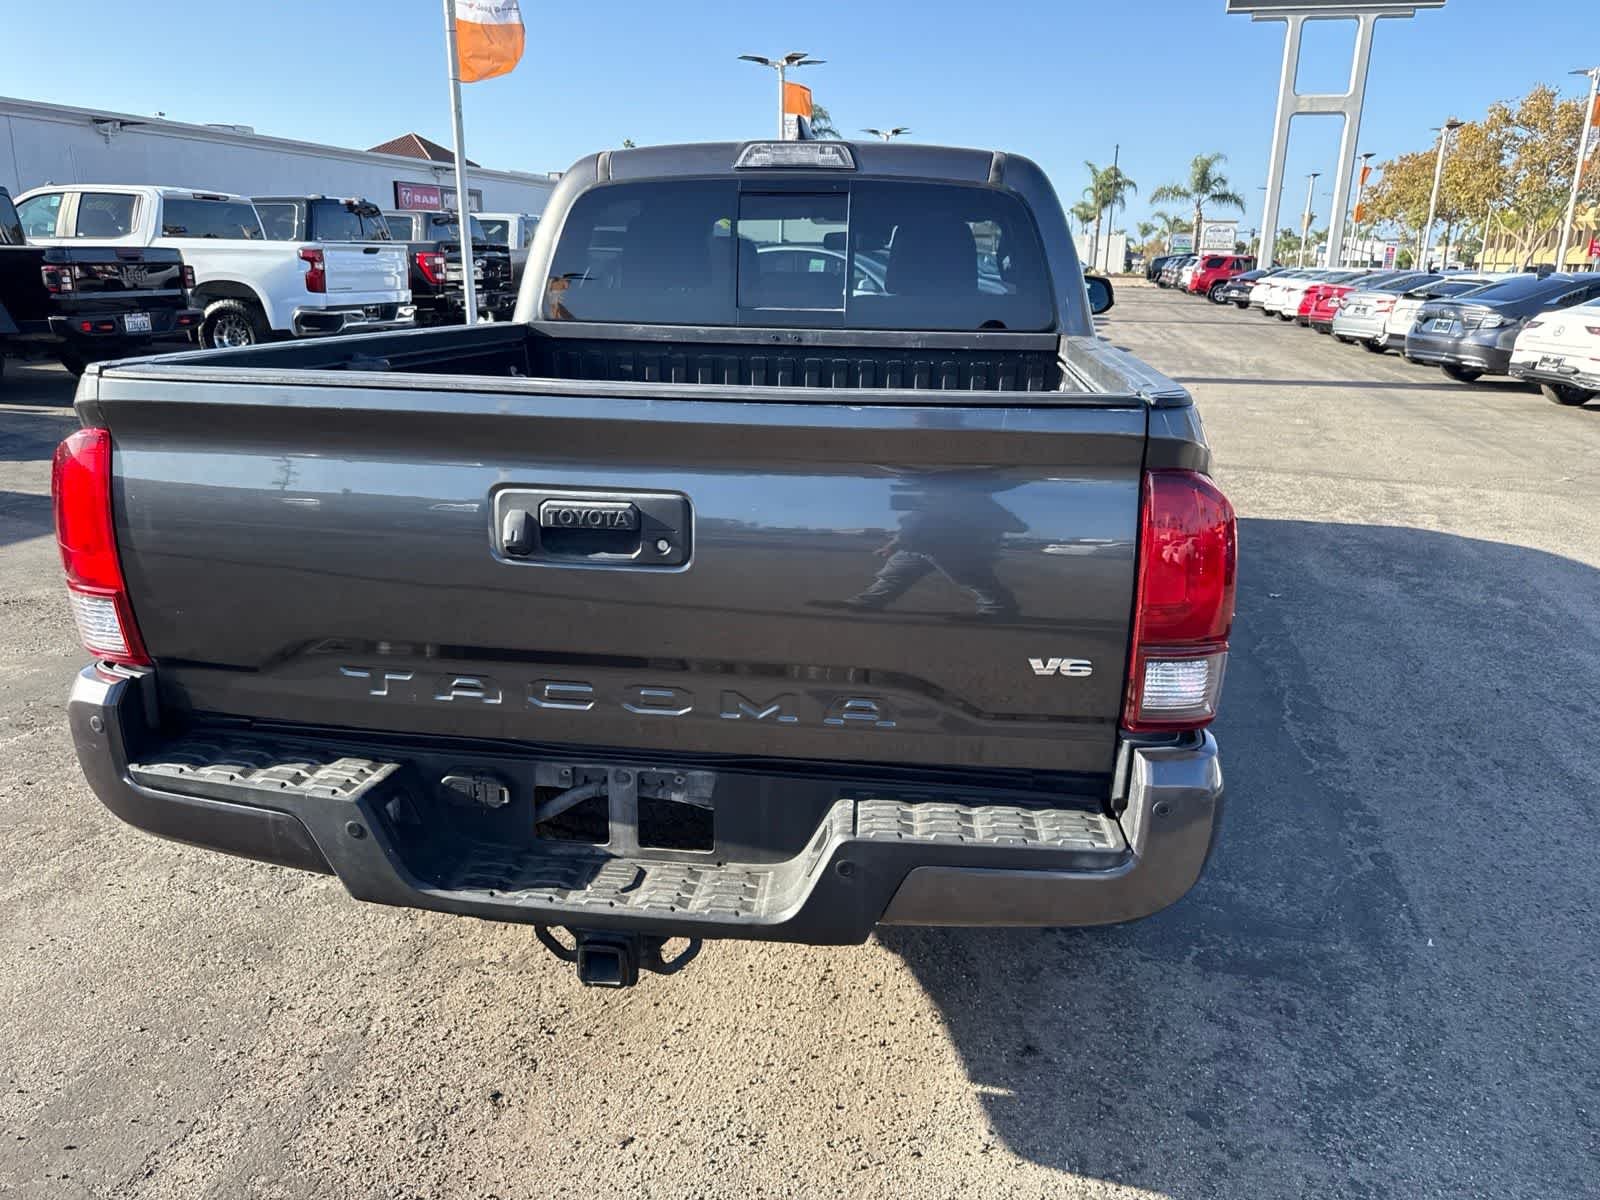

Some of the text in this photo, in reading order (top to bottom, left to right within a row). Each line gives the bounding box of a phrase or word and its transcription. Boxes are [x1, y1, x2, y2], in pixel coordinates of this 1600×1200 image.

[414, 193, 439, 204] RAM
[120, 266, 148, 282] Jeep
[546, 507, 631, 529] TOYOTA
[1027, 657, 1093, 677] V6
[339, 666, 897, 728] TACOMA
